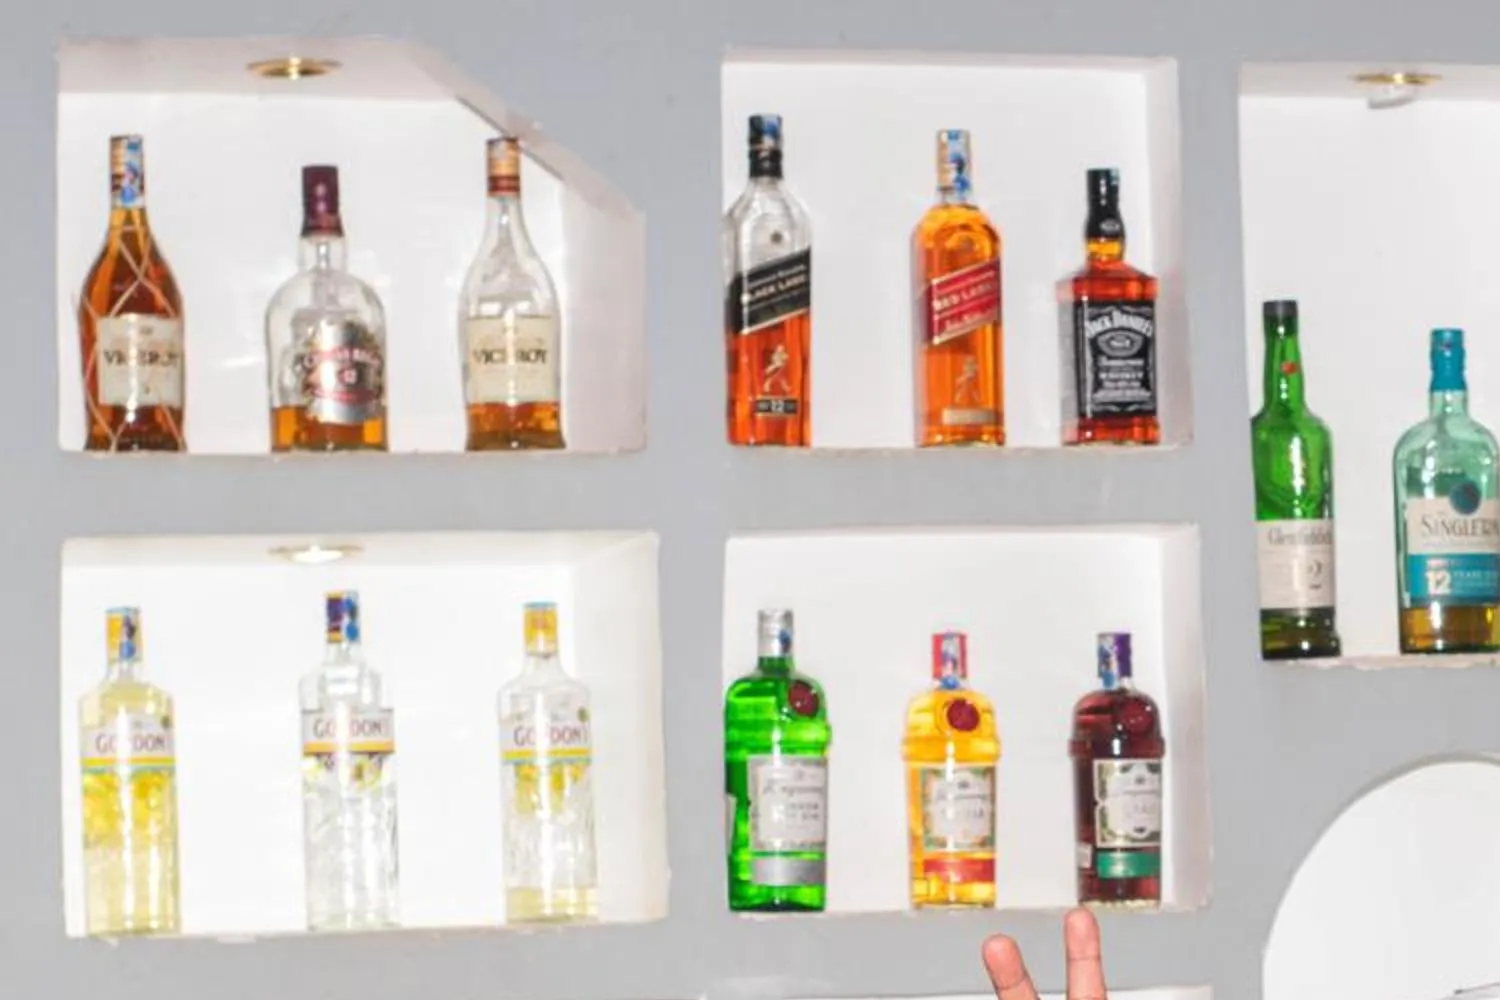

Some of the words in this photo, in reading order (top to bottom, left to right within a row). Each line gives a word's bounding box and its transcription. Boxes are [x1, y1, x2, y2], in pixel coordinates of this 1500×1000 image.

[103, 349, 179, 368] VIEROY
[472, 348, 548, 365] VICROY
[1421, 513, 1500, 540] SINGLET
